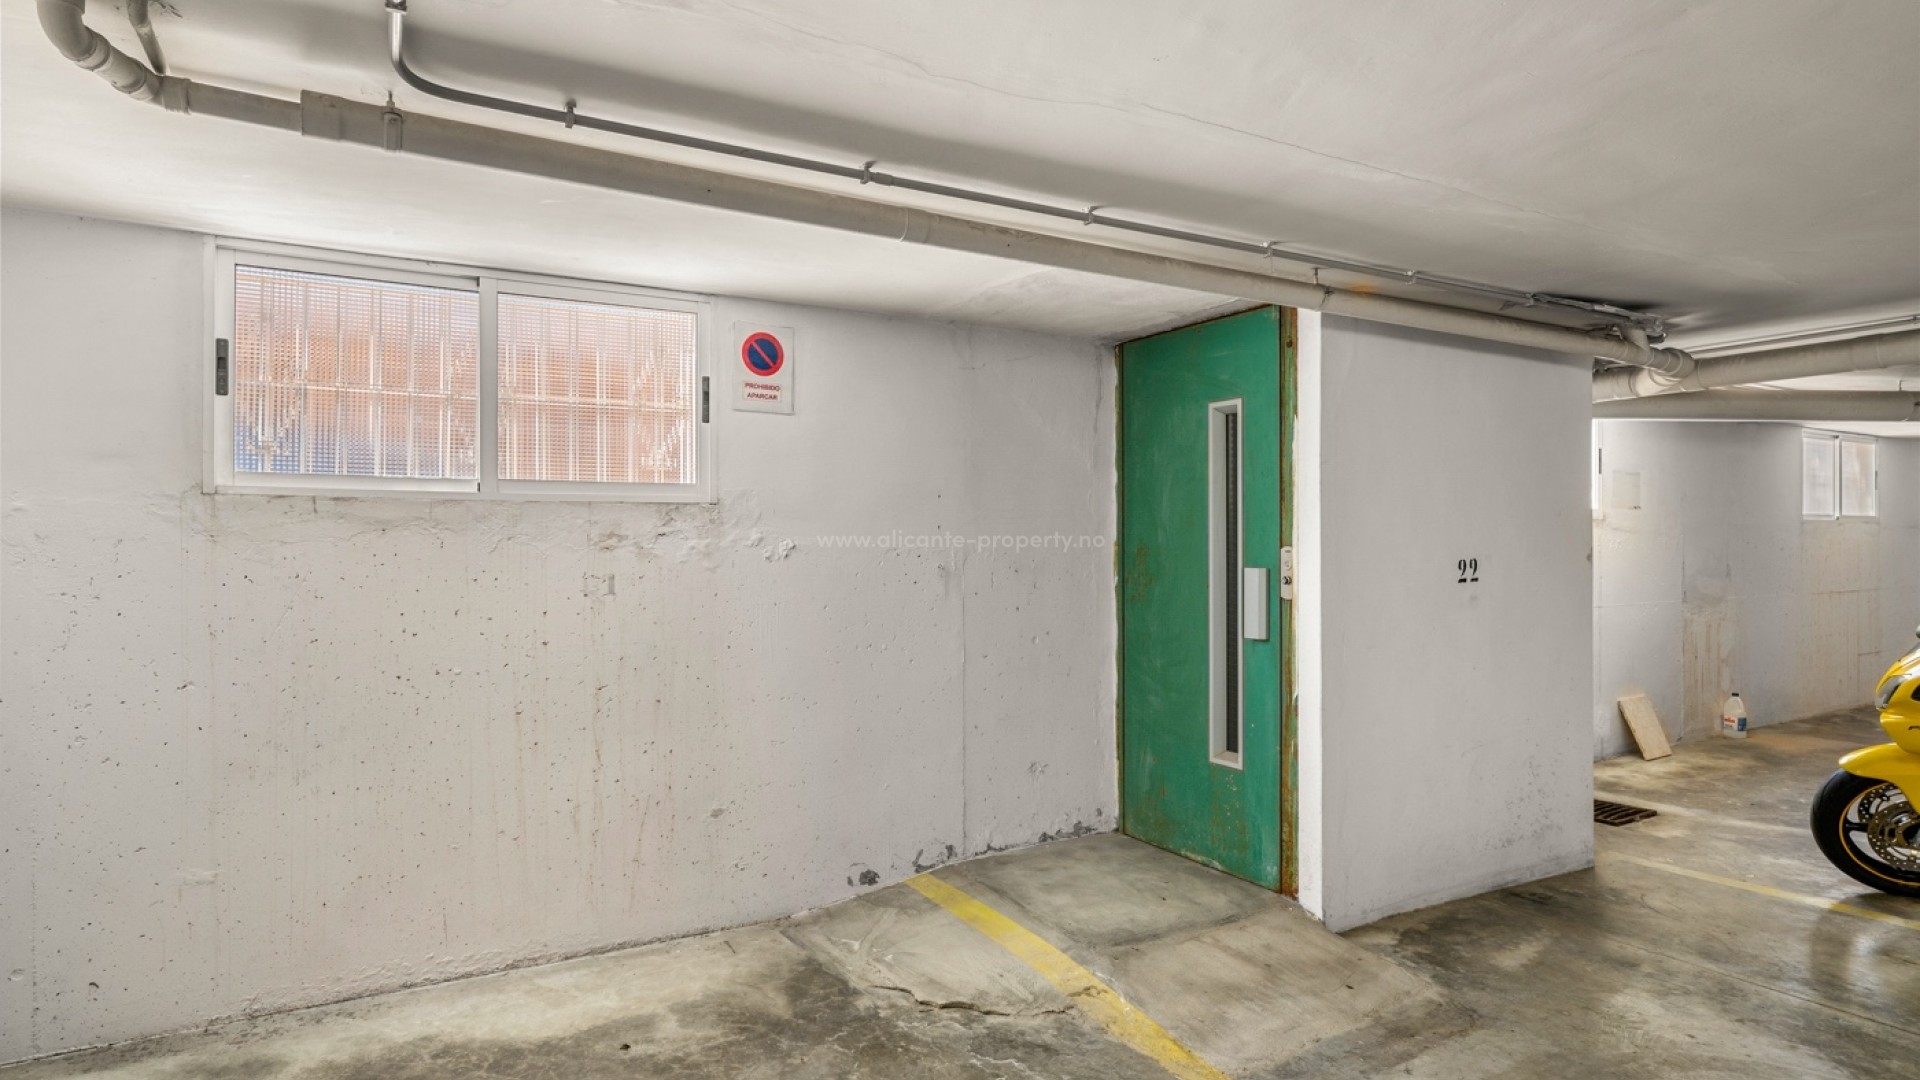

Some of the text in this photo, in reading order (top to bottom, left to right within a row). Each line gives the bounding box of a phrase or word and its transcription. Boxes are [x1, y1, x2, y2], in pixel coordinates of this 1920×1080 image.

[744, 382, 780, 391] PROHIBIDO
[747, 392, 778, 400] APARCAR
[1457, 558, 1479, 583] 22
